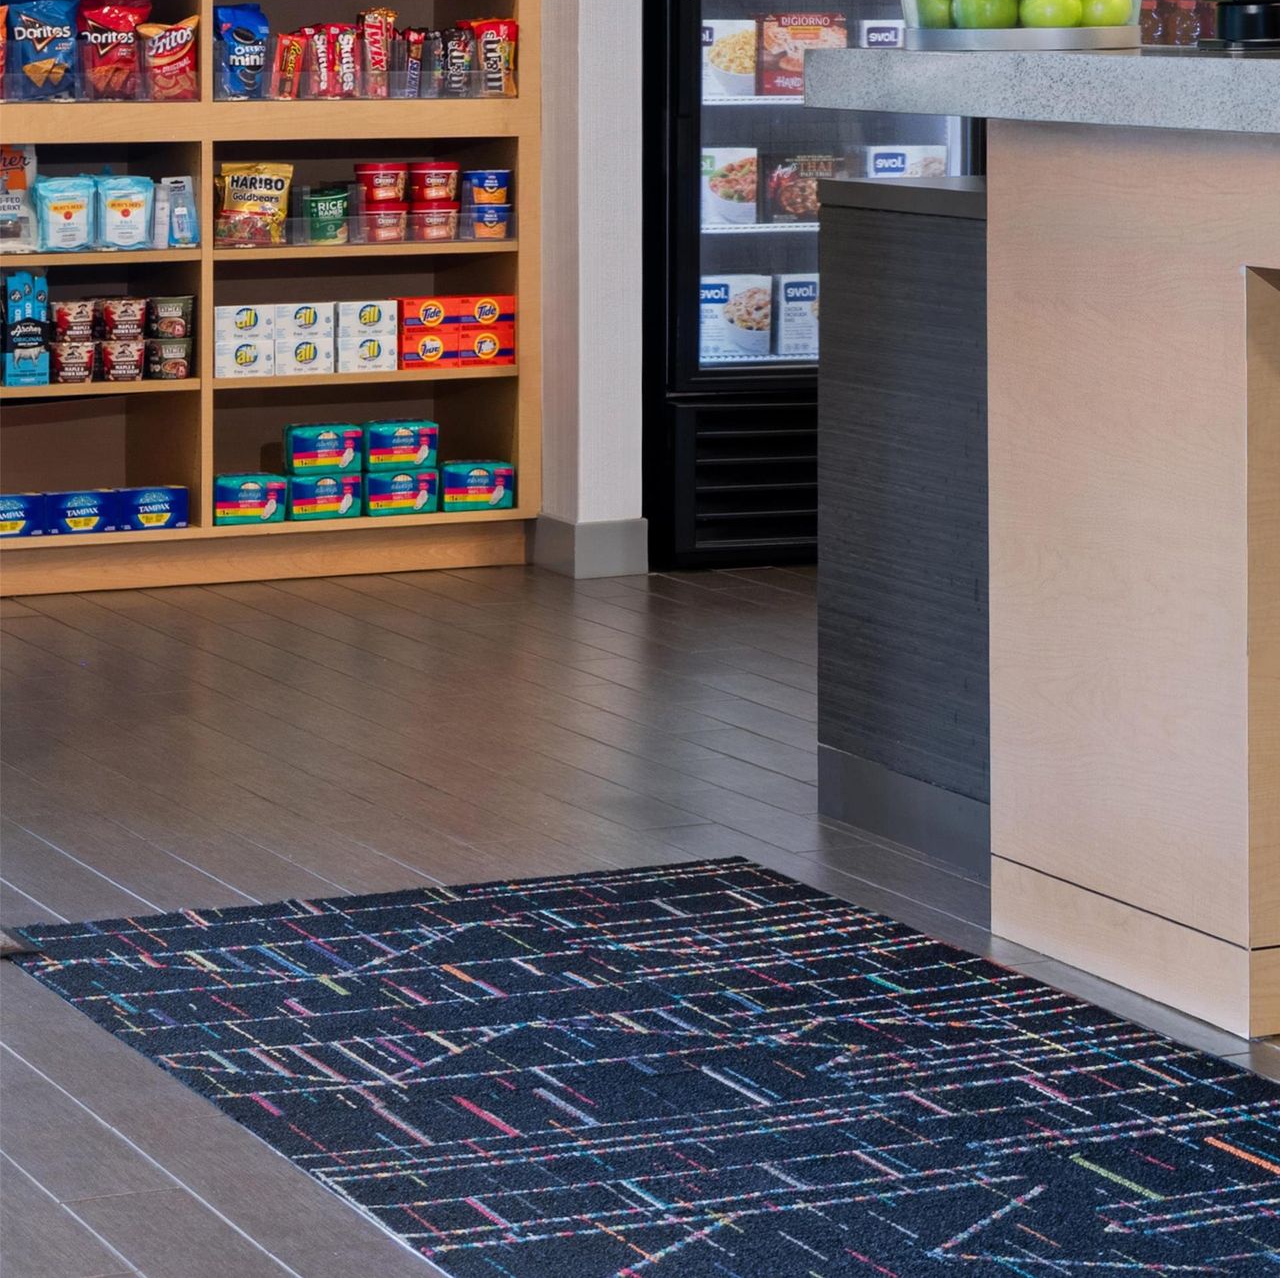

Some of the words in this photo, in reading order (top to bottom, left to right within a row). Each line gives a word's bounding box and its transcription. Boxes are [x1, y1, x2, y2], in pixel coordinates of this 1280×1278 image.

[14, 24, 71, 40] Doritos
[148, 26, 193, 56] Fritos
[313, 34, 328, 90] Skittles
[338, 33, 355, 91] Skittles
[874, 157, 905, 169] evol.
[232, 192, 279, 203] Goldbears
[317, 199, 343, 210] RICE
[318, 209, 342, 217] RAMEN
[786, 285, 816, 298] evol.
[360, 306, 379, 324] all
[422, 307, 442, 321] Tide
[477, 305, 497, 319] Tide
[296, 342, 315, 362] all
[66, 507, 99, 518] TAMPAX
[138, 503, 170, 513] TAMPAX
[0, 510, 25, 520] AMPAX
